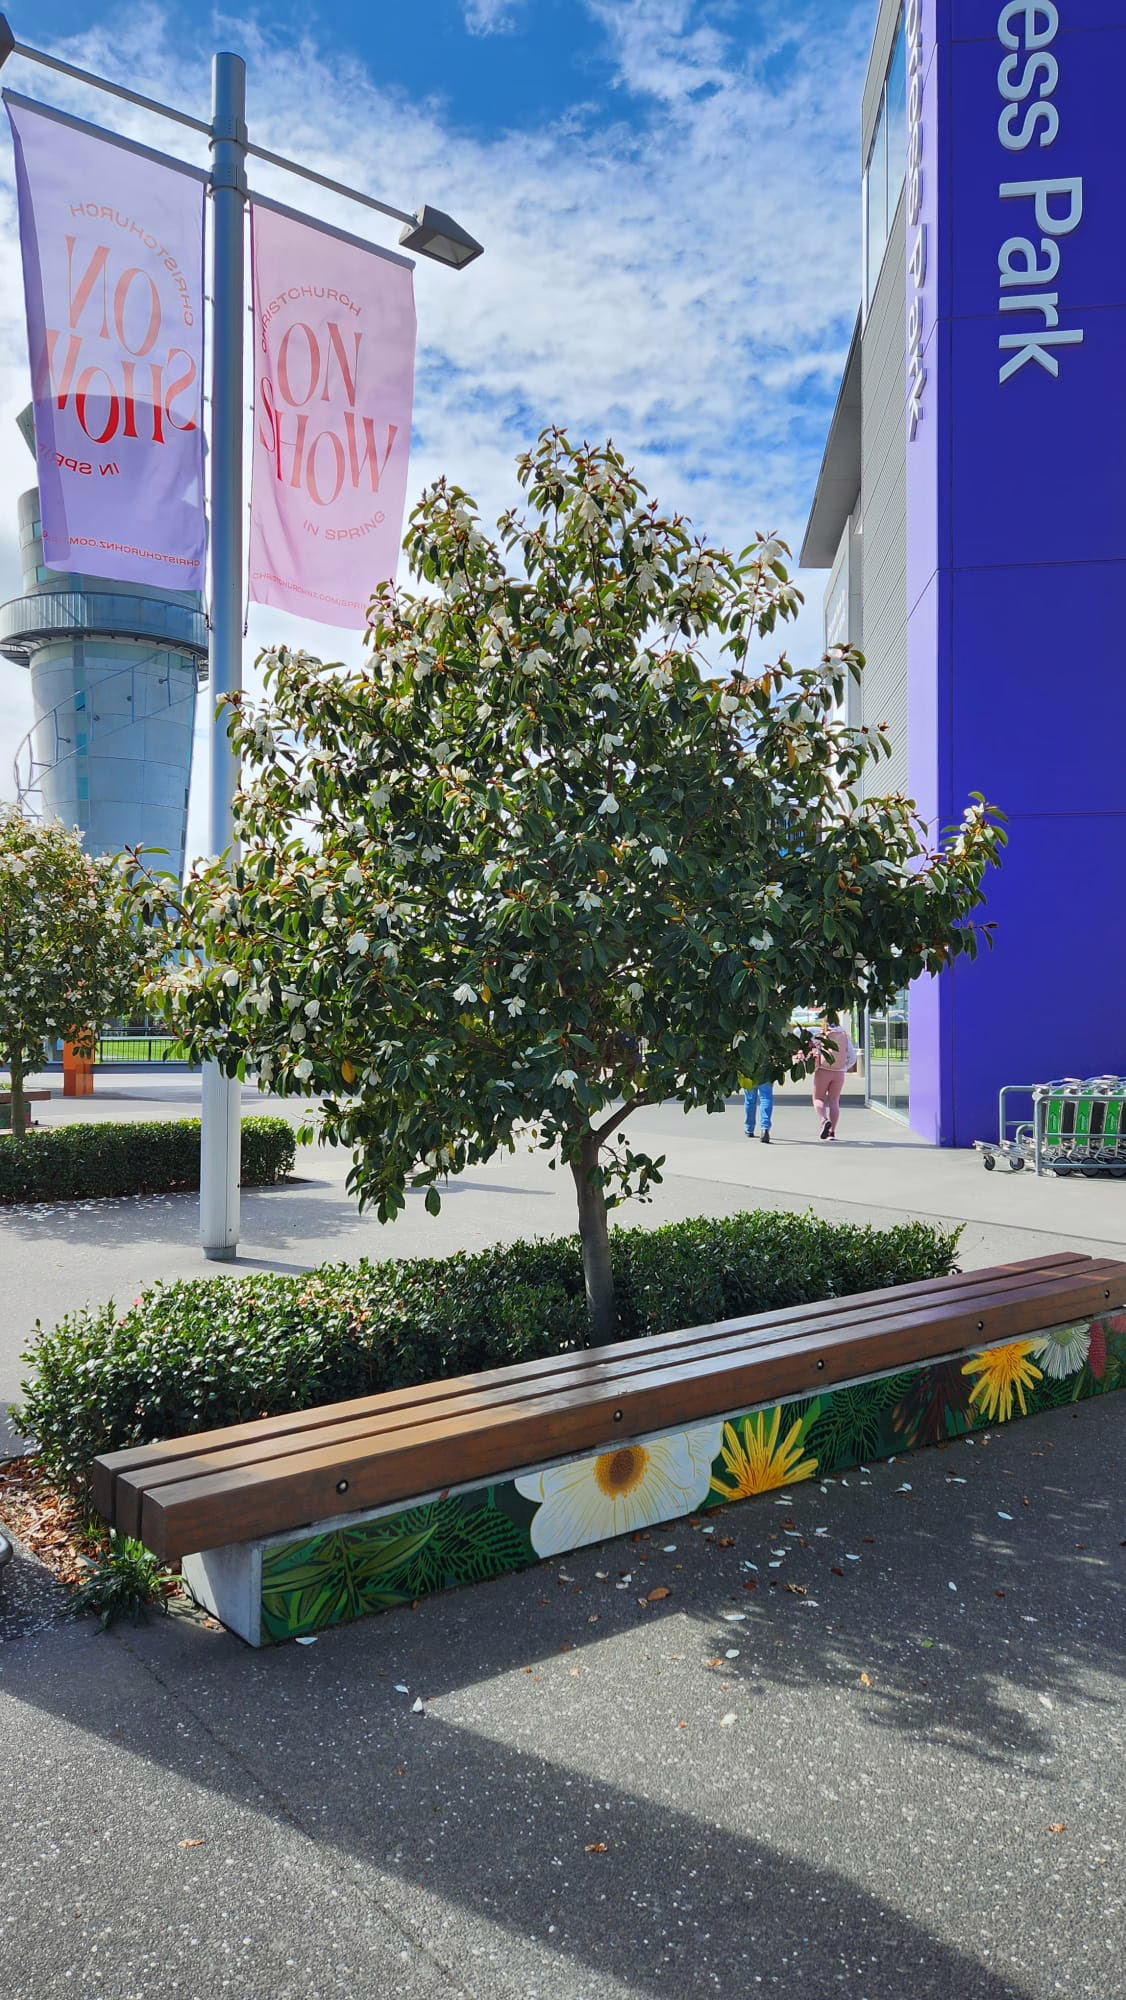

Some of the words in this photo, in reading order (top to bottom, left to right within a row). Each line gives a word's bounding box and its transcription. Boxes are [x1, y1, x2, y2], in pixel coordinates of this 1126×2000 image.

[261, 286, 362, 353] CHRISTCHURCH
[908, 224, 927, 442] Park
[998, 177, 1083, 384] Park
[277, 322, 362, 407] ON
[259, 377, 398, 506] SHOW
[303, 519, 320, 535] IN
[325, 511, 385, 541] SPRING
